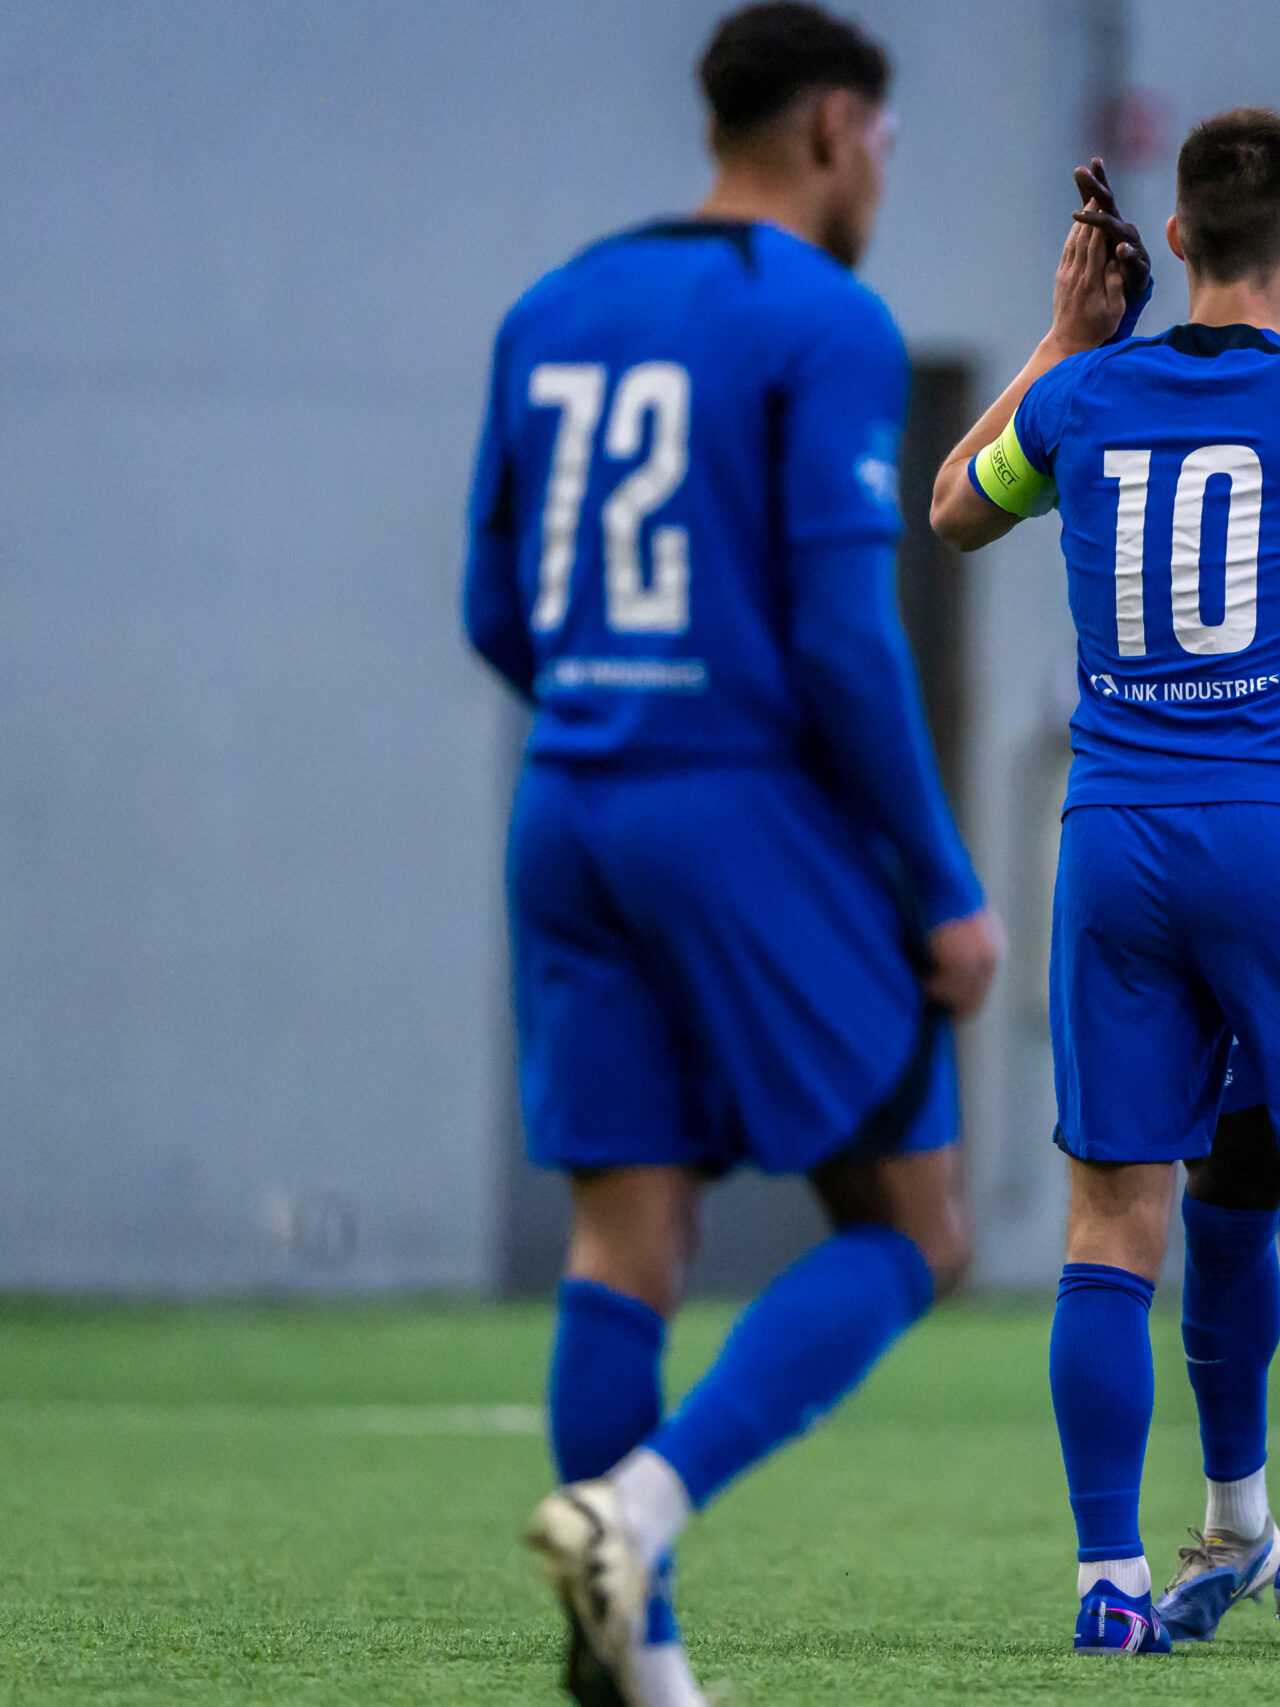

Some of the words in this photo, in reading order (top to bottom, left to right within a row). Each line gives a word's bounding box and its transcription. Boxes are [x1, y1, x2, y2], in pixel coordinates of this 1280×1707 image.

[530, 362, 690, 632] 72
[993, 440, 1017, 485] ESPECT
[1103, 445, 1263, 657] 10
